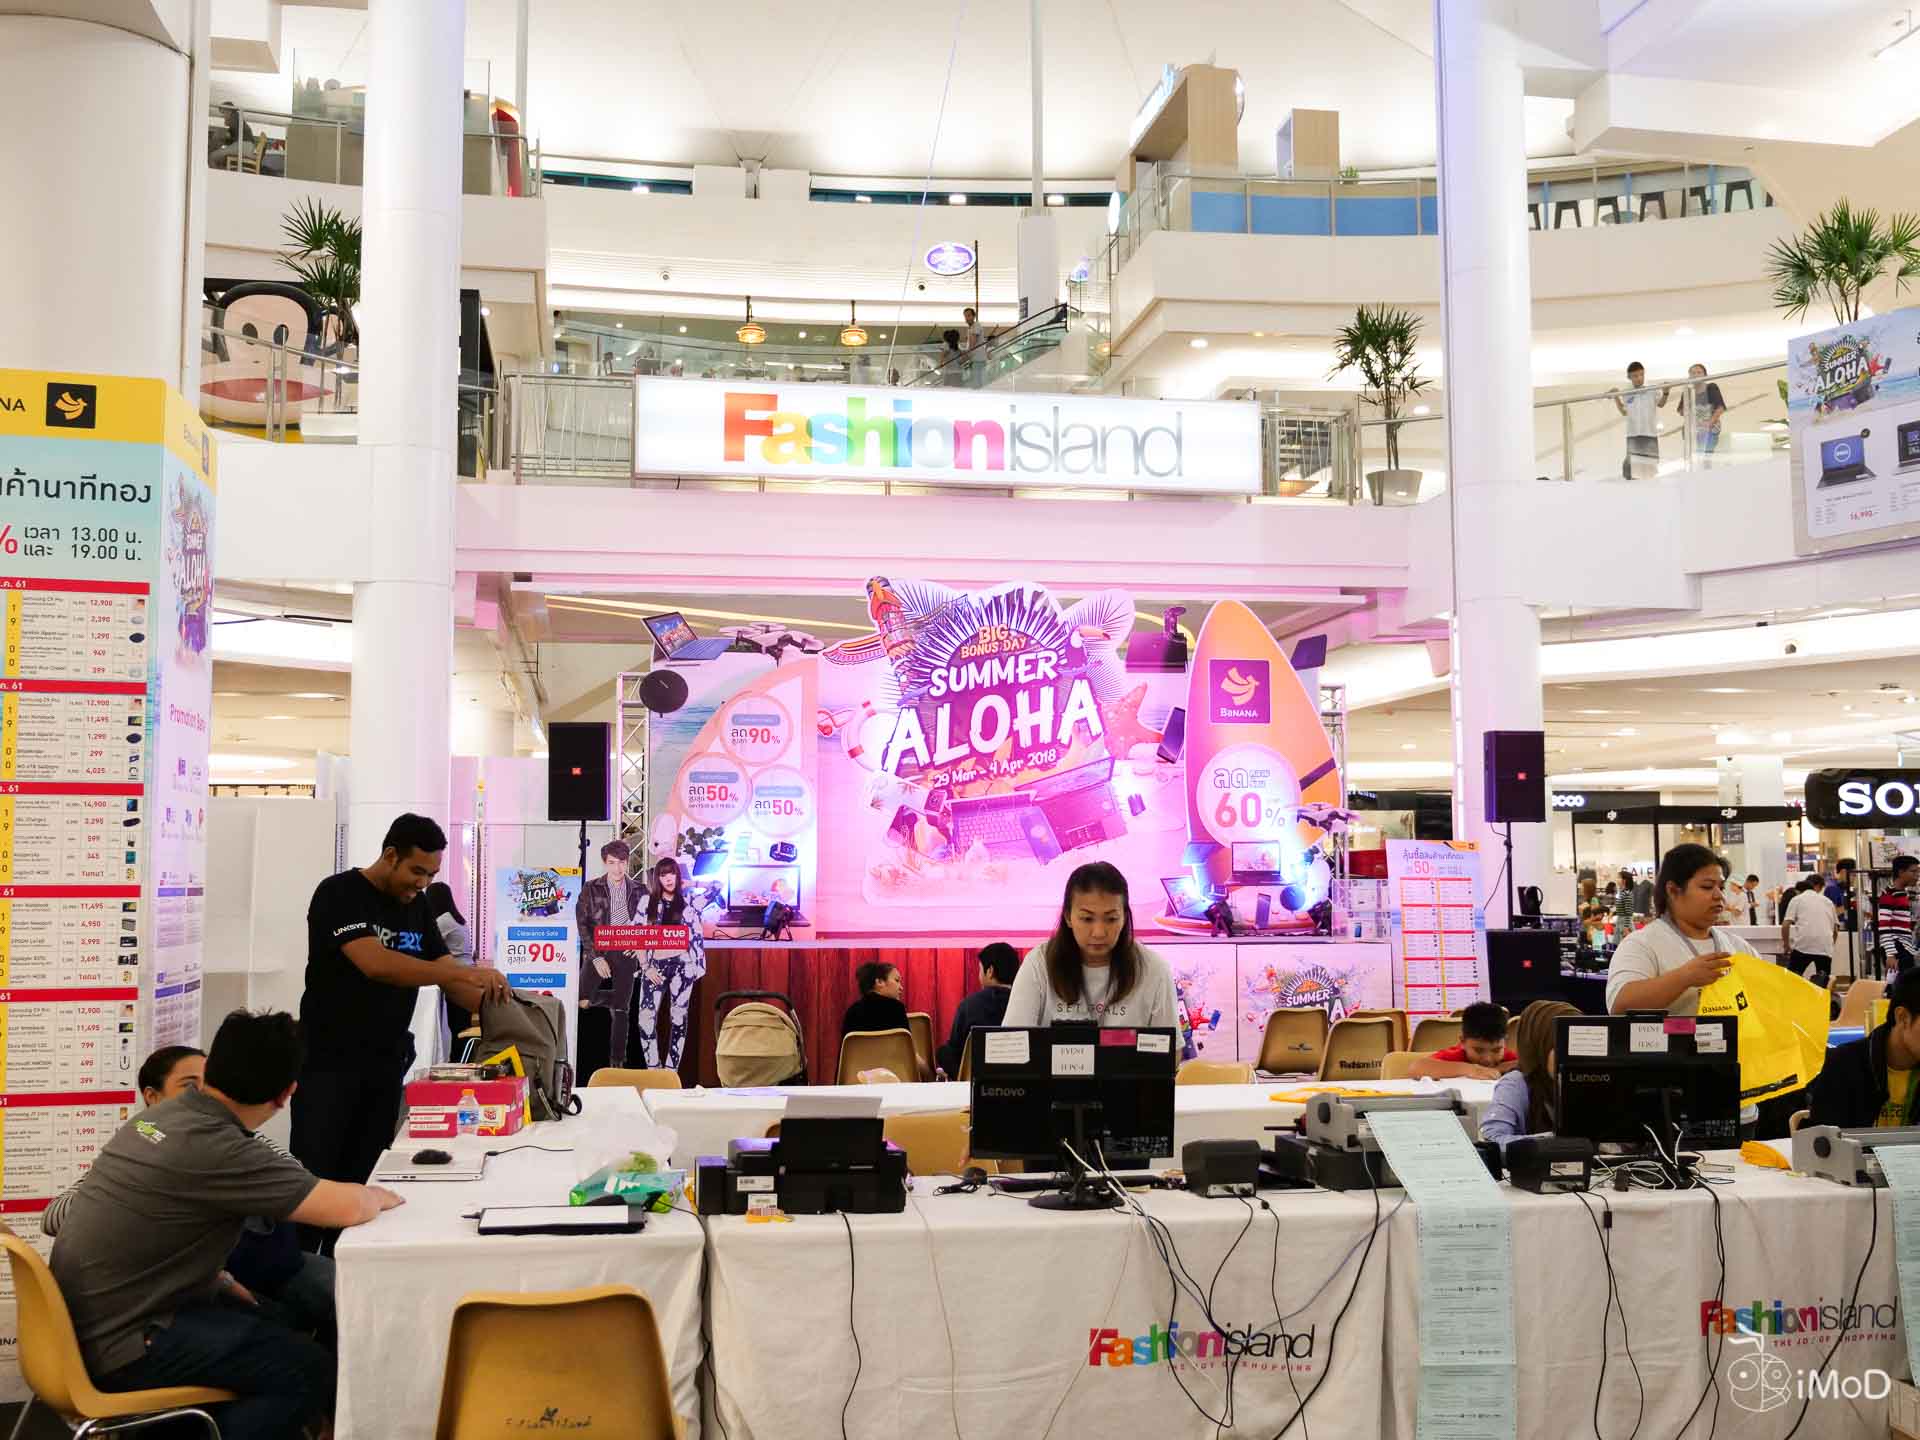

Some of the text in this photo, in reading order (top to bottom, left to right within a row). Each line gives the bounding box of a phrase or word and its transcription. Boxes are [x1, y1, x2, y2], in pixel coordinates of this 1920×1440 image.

[1814, 356, 1869, 393] ALOHA
[0, 467, 152, 504] ค้านาทีทอง
[24, 526, 143, 544] เวลา 13.00 น.
[23, 542, 142, 561] และ 19.00 น.
[15, 580, 27, 589] 61
[978, 623, 1010, 645] BIG
[961, 636, 1027, 659] BONUS DAY
[928, 649, 1059, 698] SUMMER
[884, 678, 1104, 777] ALOHA
[933, 772, 950, 789] 29
[951, 768, 977, 784] Mar
[988, 760, 998, 776] 4
[1000, 758, 1025, 775] Apr
[1027, 748, 1057, 767] 2018
[1213, 767, 1249, 789] ลด
[8, 784, 19, 793] 61
[1837, 781, 1920, 817] SO
[3, 887, 15, 897] 61
[520, 886, 557, 902] ALOHA
[333, 922, 368, 937] LINKSYS
[649, 928, 659, 936] BY
[663, 928, 686, 938] true
[507, 944, 526, 955] ลด
[1286, 988, 1331, 1007] SUMMER
[1056, 1002, 1081, 1013] SET
[1569, 1072, 1611, 1083] Lenovo
[980, 1084, 1025, 1098] Lenovo
